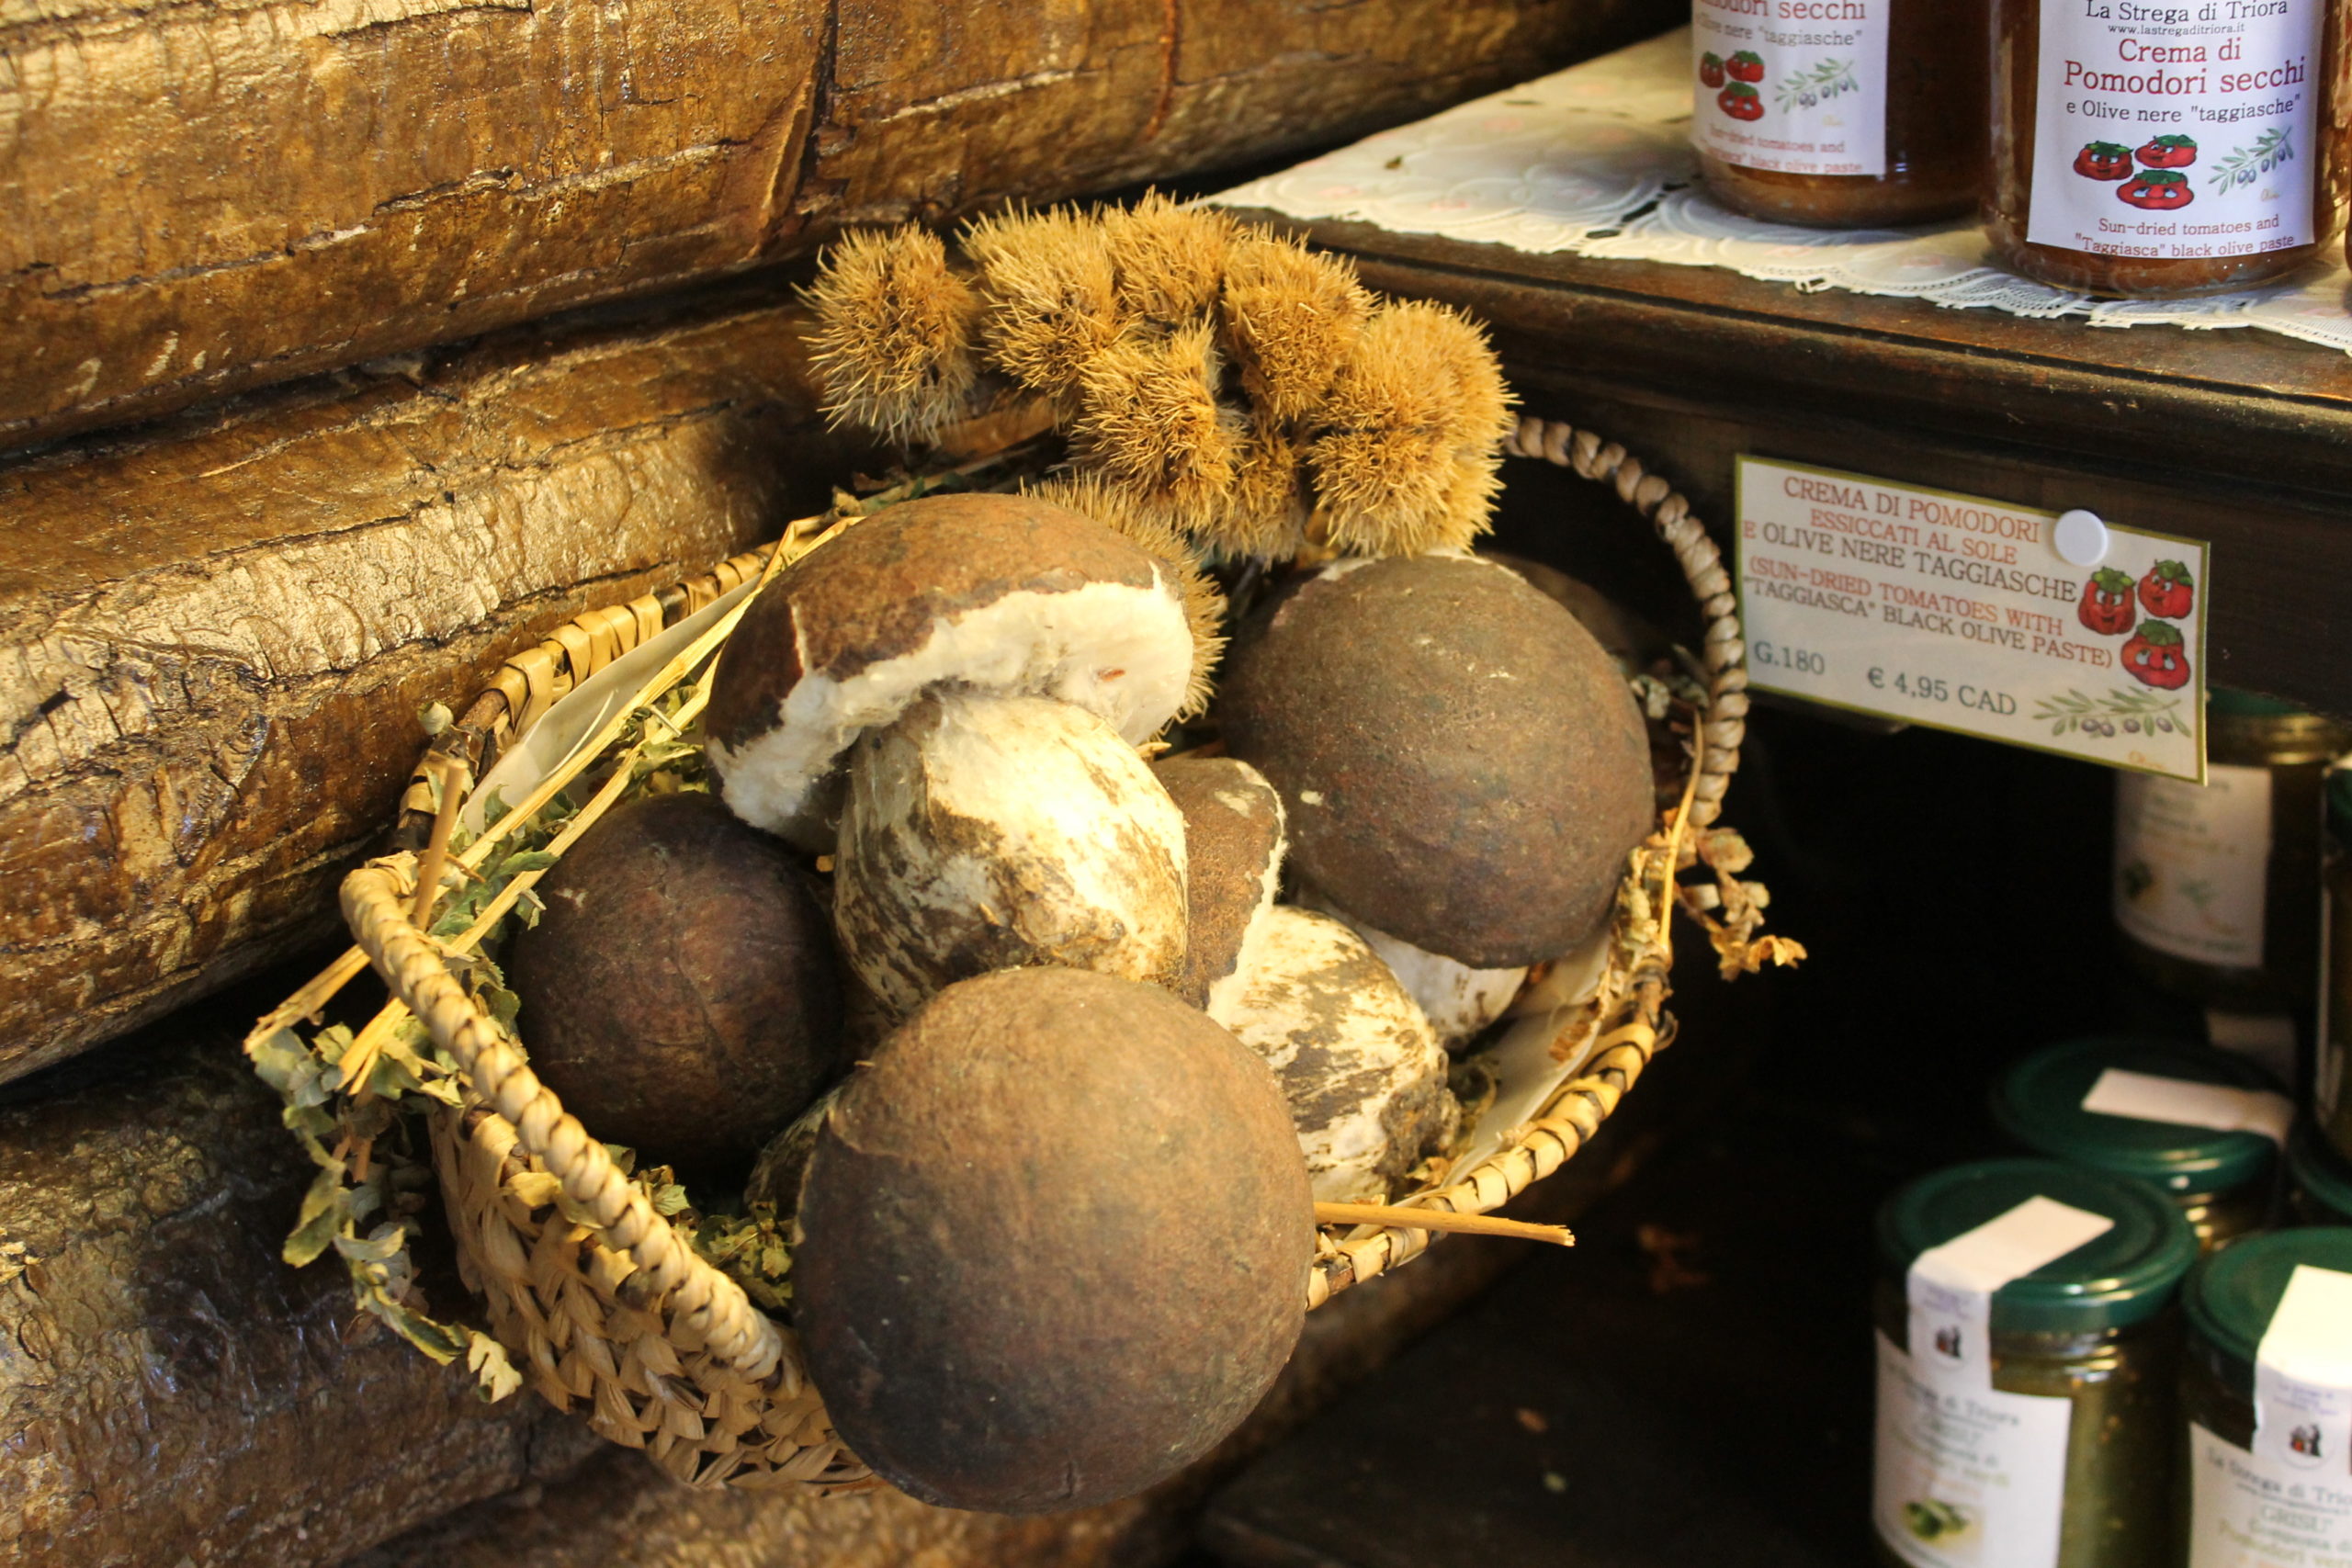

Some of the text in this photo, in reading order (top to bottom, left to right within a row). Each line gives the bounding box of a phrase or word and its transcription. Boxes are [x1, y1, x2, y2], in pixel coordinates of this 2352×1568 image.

[2086, 0, 2288, 25] La Strega di Triora
[2108, 22, 2245, 37] www.lastregaditriora.it
[2119, 37, 2242, 63] Crema di
[2064, 56, 2305, 95] Pomodori secchi
[2066, 94, 2301, 123] e Olive nere "taggiasche"
[2075, 231, 2294, 257] "Taggiasca" black olive paste
[2098, 213, 2279, 236] Sun-dried tomatoes and
[1784, 476, 2041, 544] CREMA DI POMODORI
[1810, 508, 2018, 566] ESSICCATI AL SOLE
[1743, 520, 2077, 603] E OLIVE NERE TAGGIASCHE
[1749, 556, 2064, 636] (SUN-DRIED TOMATOES WITH
[1744, 576, 2113, 669] "TAGGIASCA" BLACK OLIVE PASTE)
[1754, 641, 1826, 675] G.180
[1868, 666, 1884, 689] €
[1958, 684, 2018, 716] CAD
